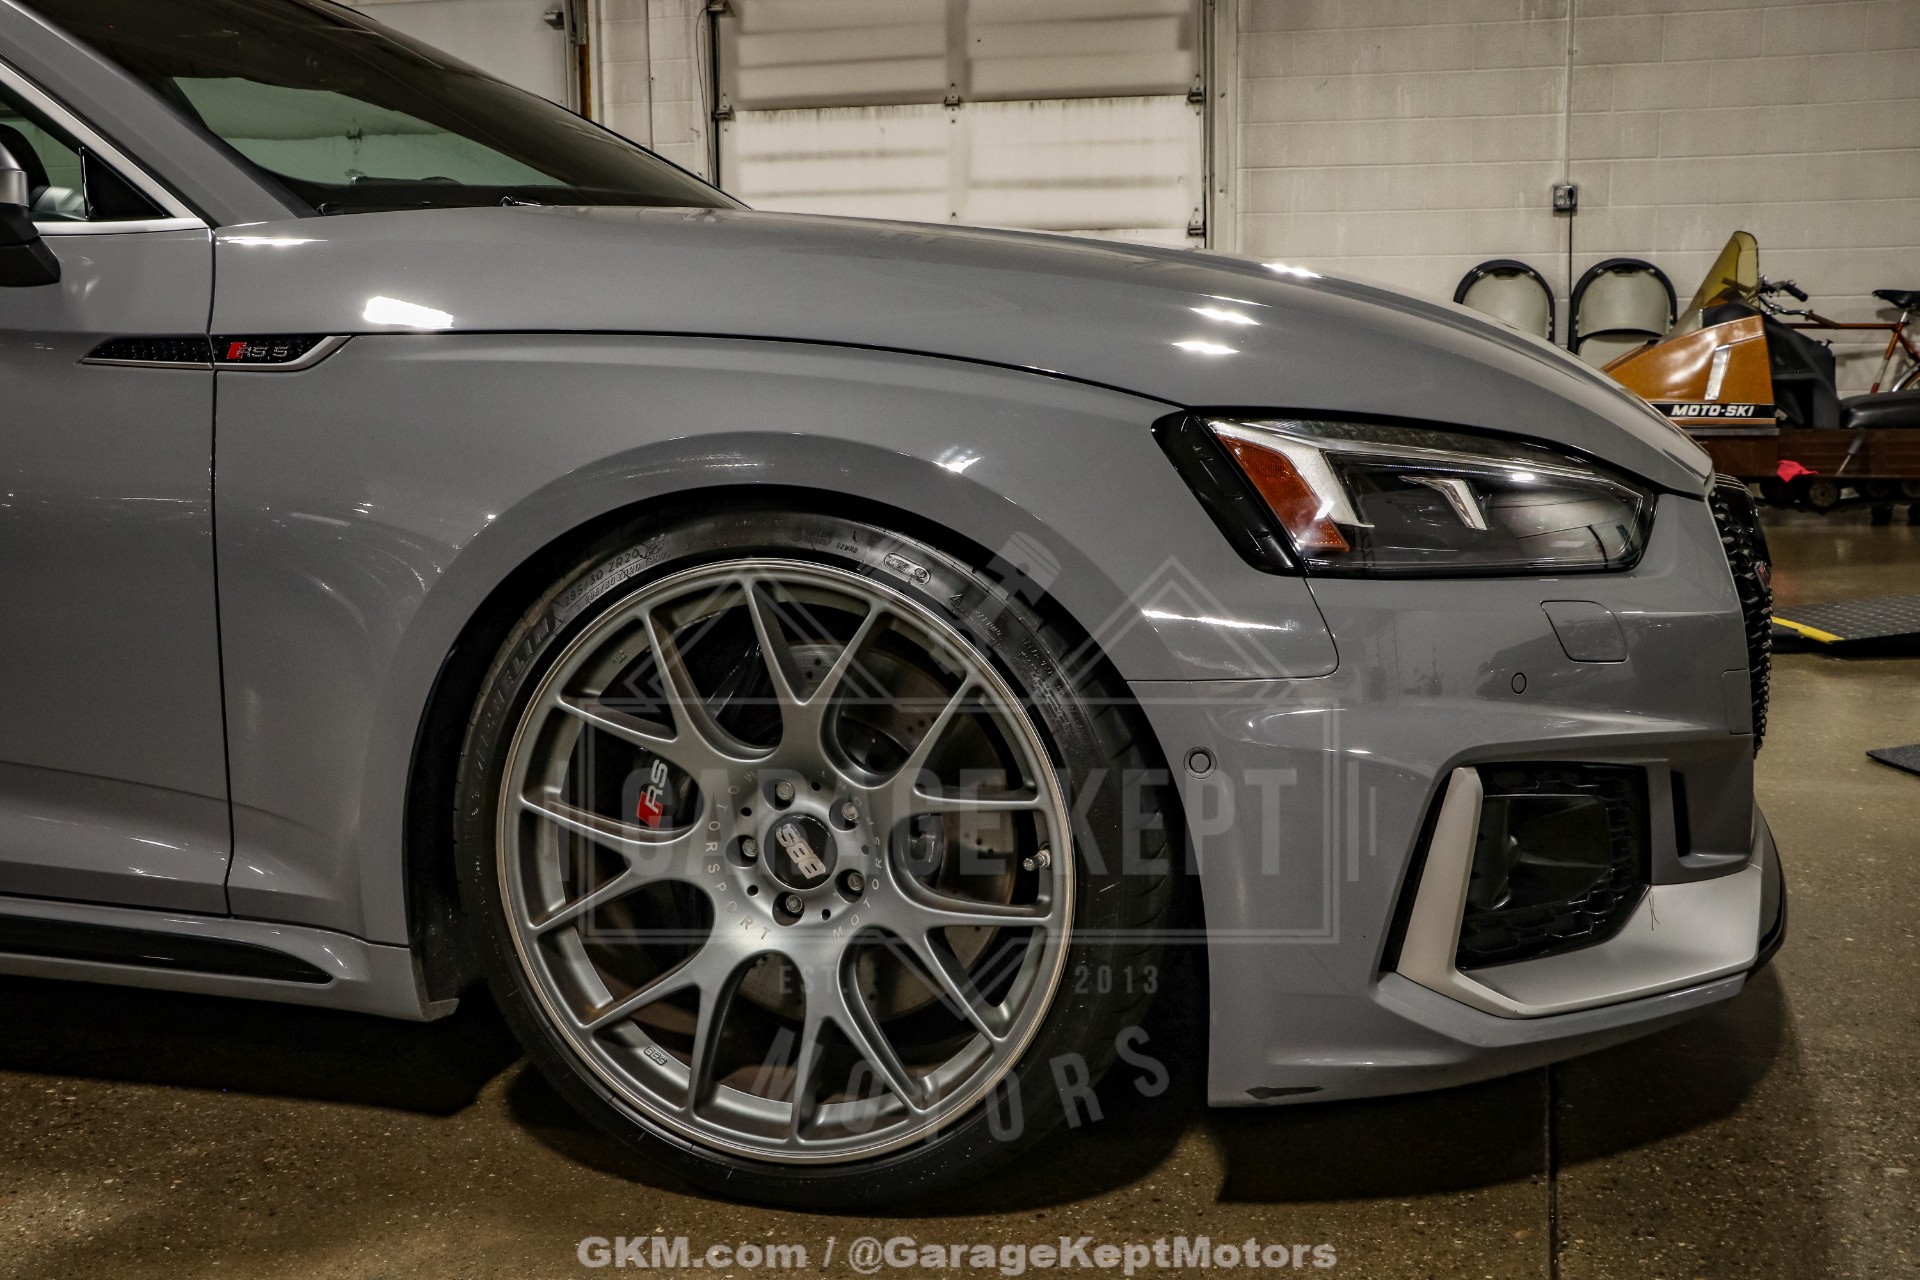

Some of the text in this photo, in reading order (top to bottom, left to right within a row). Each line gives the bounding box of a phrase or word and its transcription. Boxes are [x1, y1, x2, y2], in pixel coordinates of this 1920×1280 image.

[1671, 405, 1754, 417] MOTO-SKI
[645, 758, 668, 815] RS
[775, 823, 827, 880] BBS
